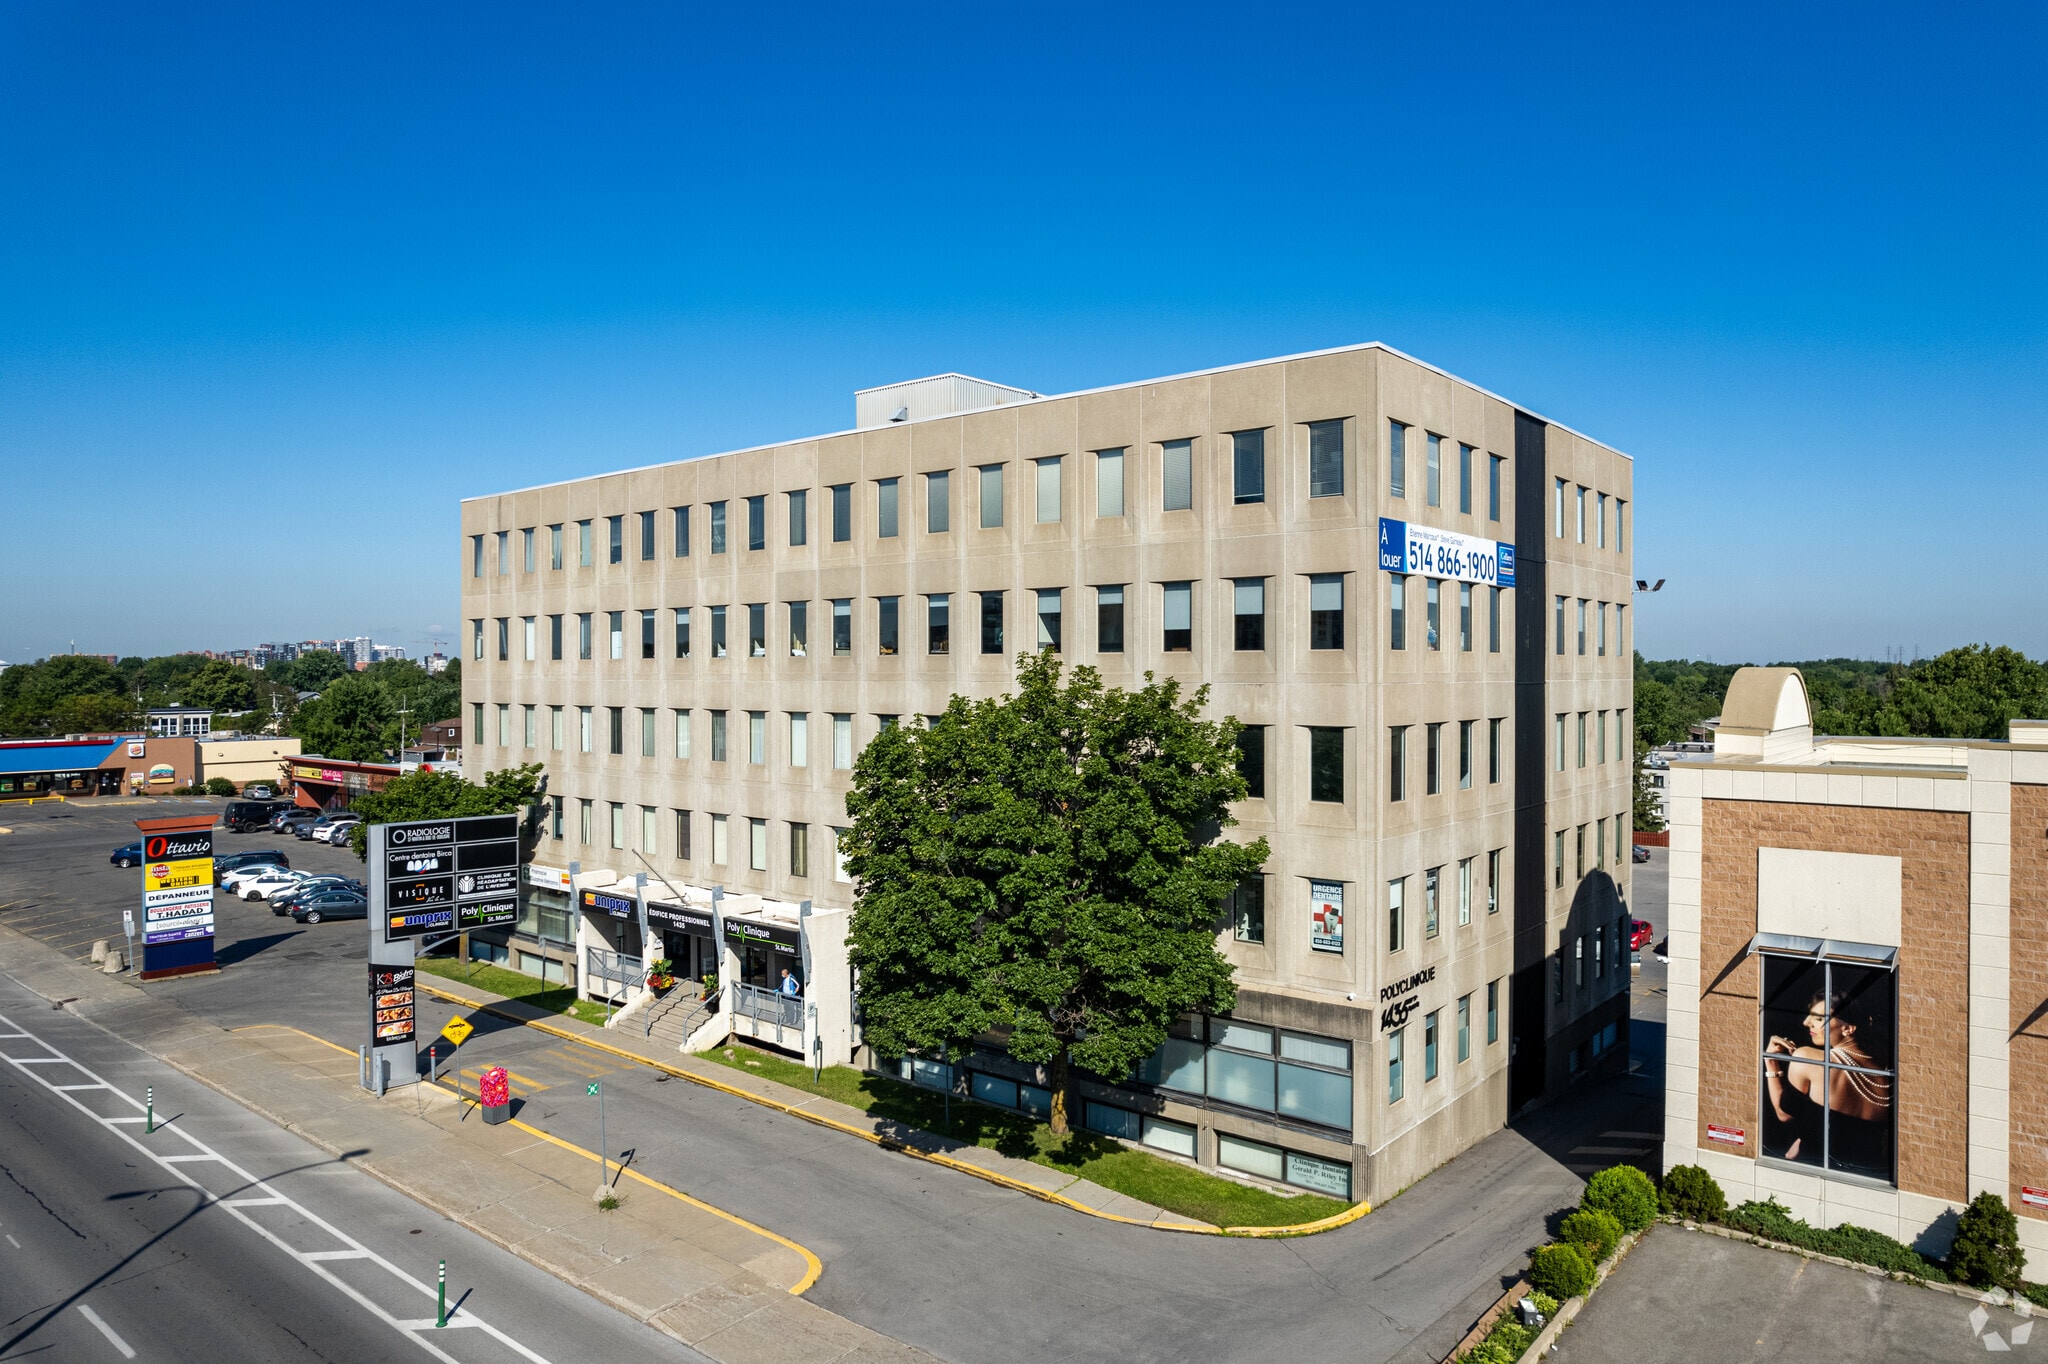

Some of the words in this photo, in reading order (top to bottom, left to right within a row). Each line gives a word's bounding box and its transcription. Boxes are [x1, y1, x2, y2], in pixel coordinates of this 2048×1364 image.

[1381, 522, 1389, 545] À
[1381, 549, 1401, 568] louer
[1410, 541, 1433, 572] 514
[1438, 546, 1495, 581] 866-1900
[407, 827, 451, 837] RADIOLOGIE
[147, 837, 211, 858] Ottavio
[389, 854, 411, 862] Centre
[411, 851, 436, 860] dentaire
[477, 873, 502, 881] CLINIQUE
[398, 886, 444, 899] VISIQUE
[1313, 885, 1342, 895] URGENCE
[1313, 892, 1342, 902] DENTAIRE
[461, 906, 479, 916] Poly
[482, 903, 514, 913] Clinique
[595, 895, 630, 915] uniprix
[404, 911, 452, 928] uniprix
[612, 910, 628, 919] CLINIQUE
[648, 908, 668, 919] ÉDIFICE
[668, 911, 710, 926] PROFESSIONNEL
[673, 921, 686, 929] 1435
[726, 921, 740, 935] Poly
[743, 925, 770, 939] Clinique
[782, 945, 795, 954] Martin
[393, 969, 413, 984] Bistro
[1380, 966, 1436, 1004] POLYCLINIQUE
[1381, 999, 1409, 1032] 1435
[1294, 1158, 1319, 1169] Clinique
[1322, 1164, 1347, 1175] Dentaire
[1313, 1169, 1320, 1177] P.
[1321, 1171, 1336, 1181] Riley
